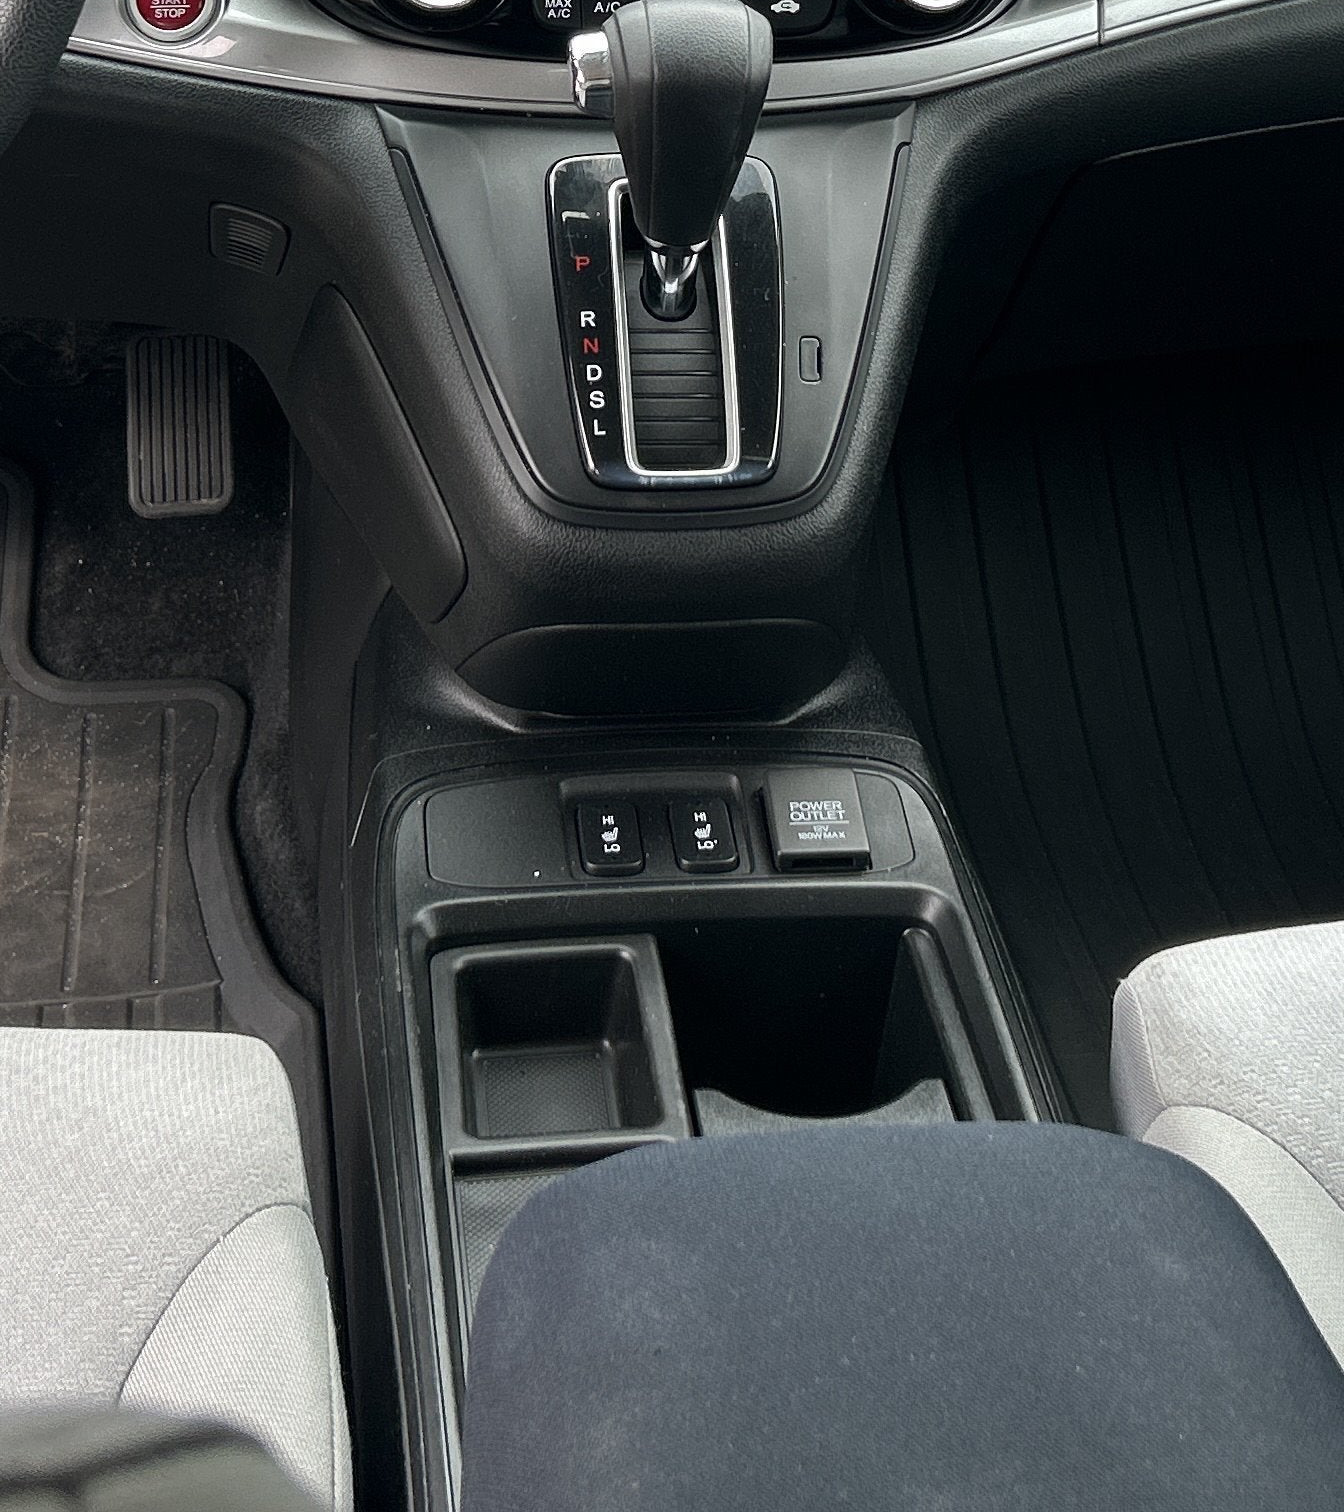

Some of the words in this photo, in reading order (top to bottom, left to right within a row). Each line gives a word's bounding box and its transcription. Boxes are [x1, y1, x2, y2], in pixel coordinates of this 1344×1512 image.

[155, 8, 186, 18] STOP
[548, 8, 571, 18] A/C
[594, 2, 620, 13] A/C
[575, 256, 590, 271] P
[580, 311, 596, 327] R
[583, 338, 598, 353] N
[587, 365, 602, 381] D
[589, 390, 605, 409] S
[594, 420, 606, 435] L
[790, 801, 842, 811] POWER
[602, 815, 614, 825] HI
[694, 812, 707, 822] HI
[790, 810, 846, 821] OUTLET
[604, 844, 620, 853] LO
